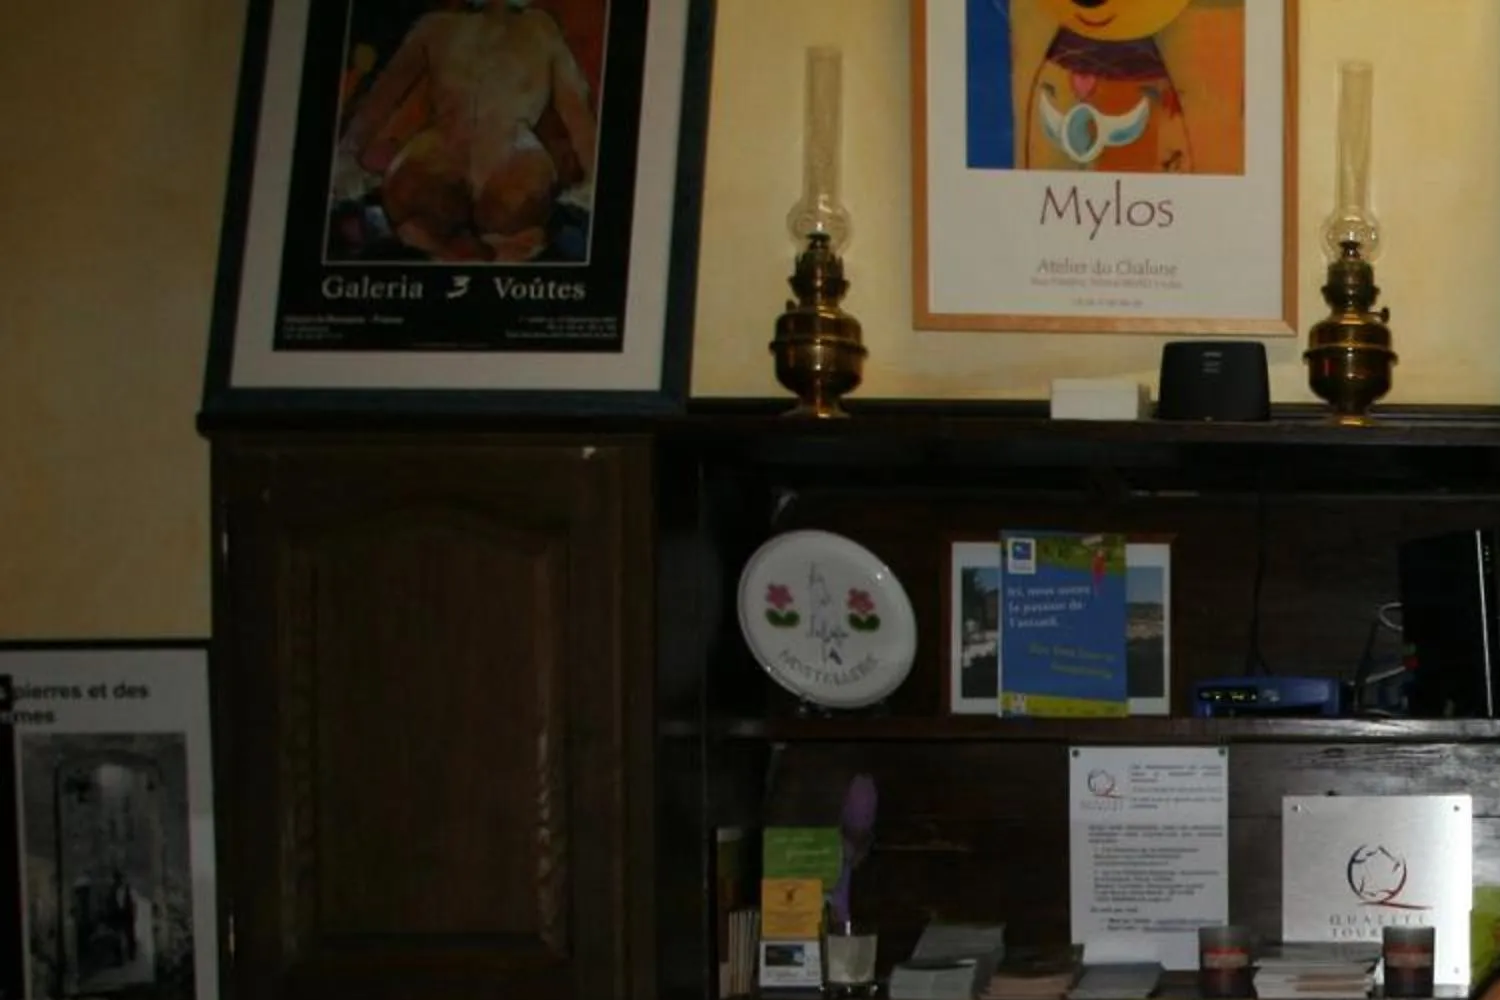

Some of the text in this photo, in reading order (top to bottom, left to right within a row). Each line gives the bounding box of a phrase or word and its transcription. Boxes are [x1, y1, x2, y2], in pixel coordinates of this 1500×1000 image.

[1039, 179, 1175, 241] Mylos
[321, 275, 424, 300] Galeria
[113, 680, 149, 700] des
